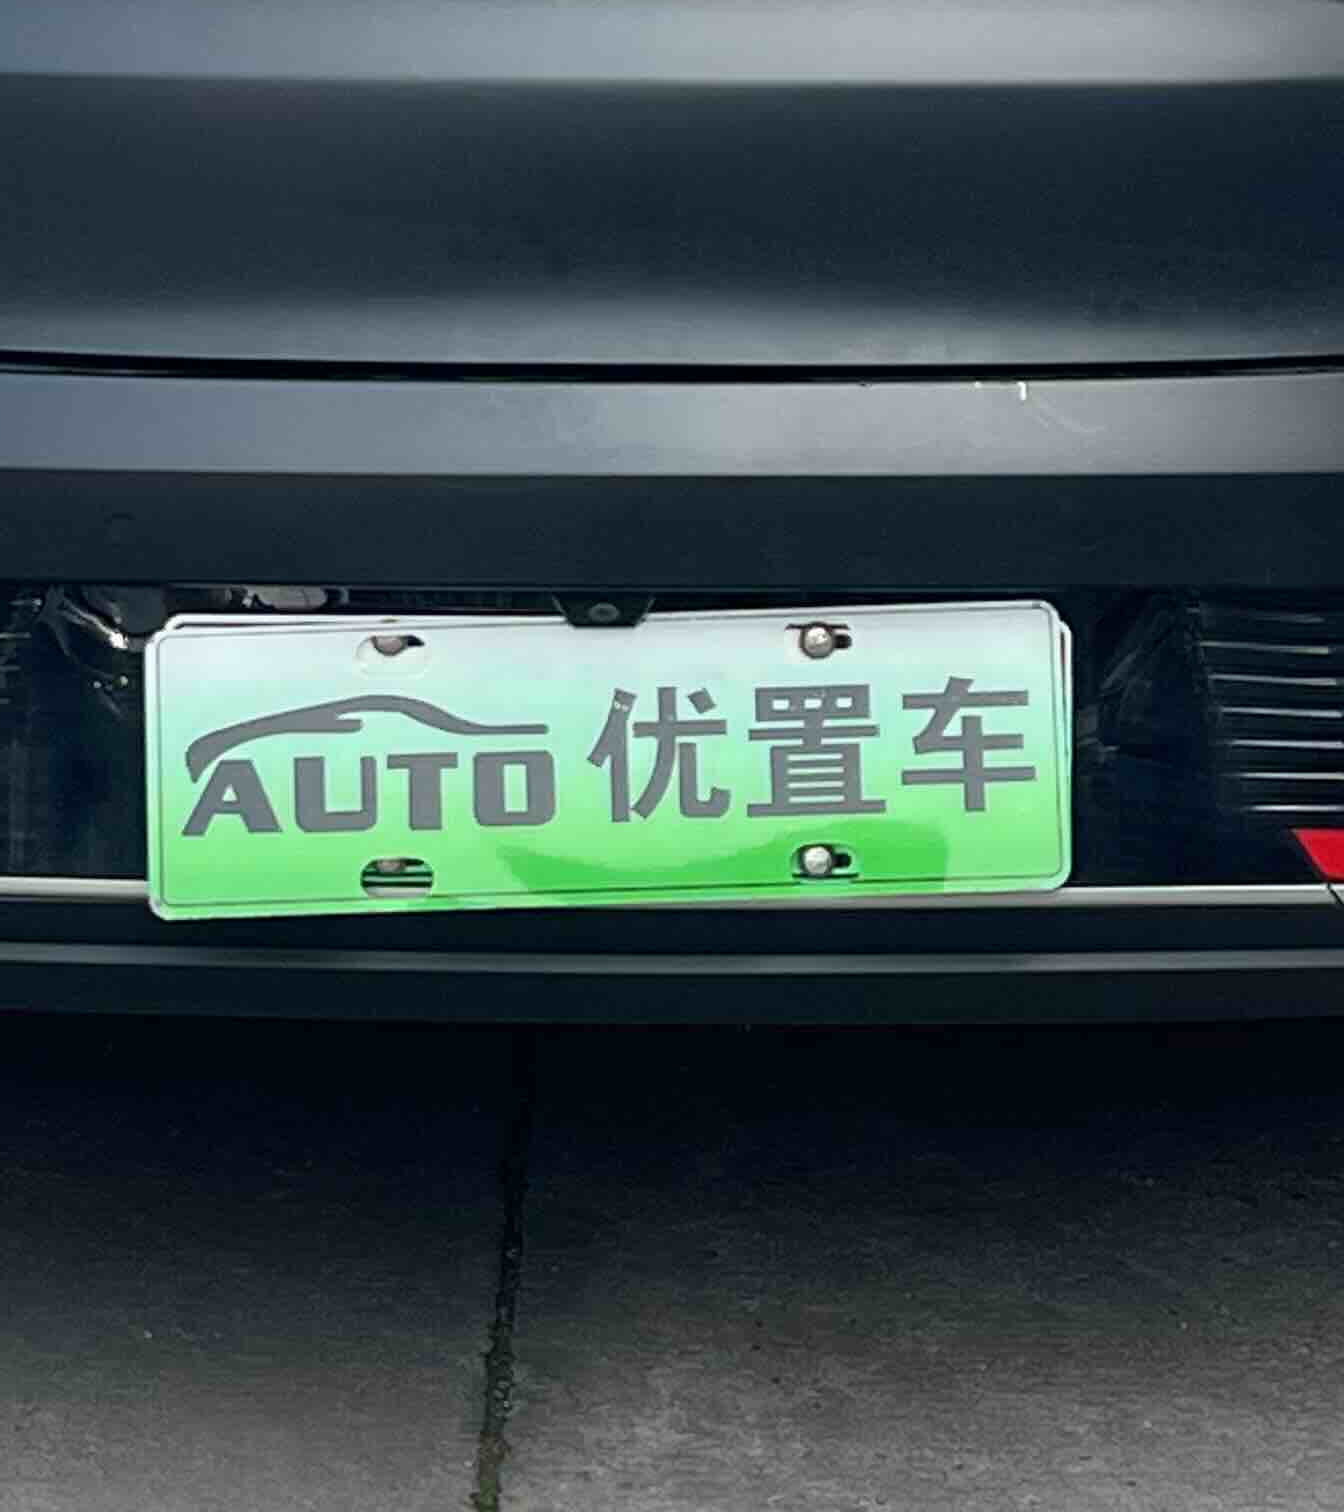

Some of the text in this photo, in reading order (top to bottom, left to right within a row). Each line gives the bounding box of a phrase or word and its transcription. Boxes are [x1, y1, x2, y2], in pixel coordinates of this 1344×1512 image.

[181, 676, 1038, 836] AUTO 优置车
